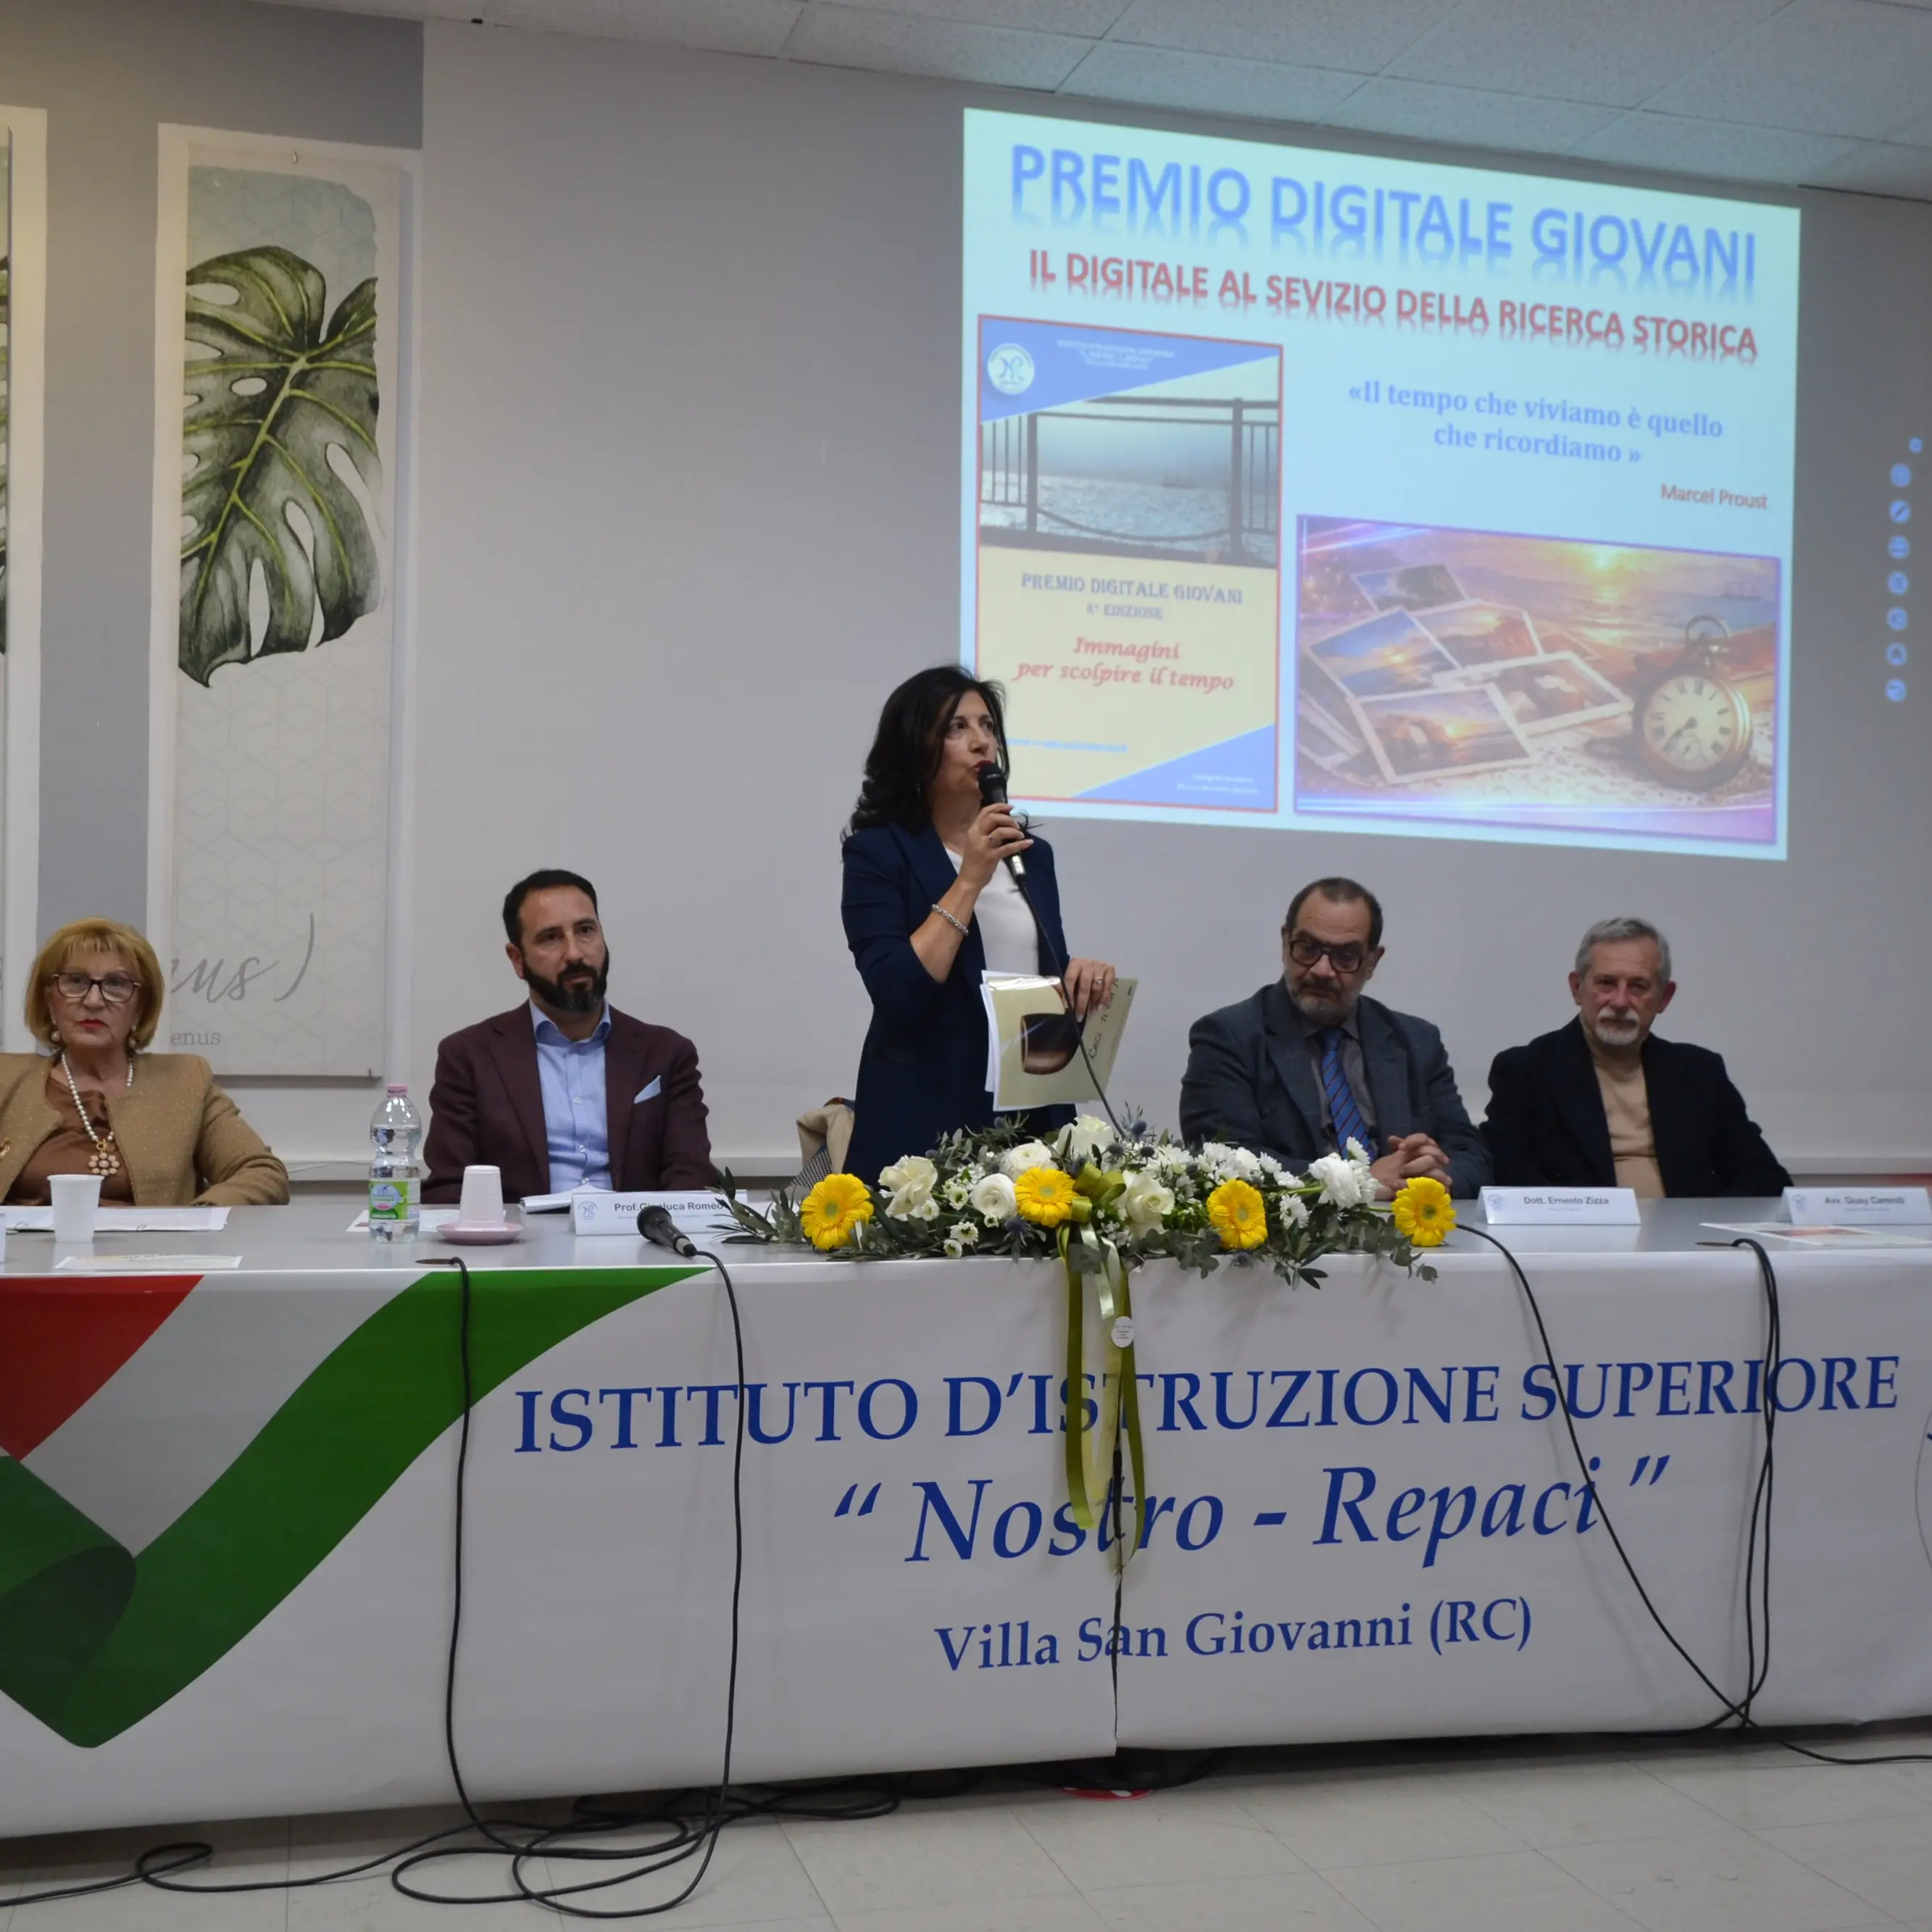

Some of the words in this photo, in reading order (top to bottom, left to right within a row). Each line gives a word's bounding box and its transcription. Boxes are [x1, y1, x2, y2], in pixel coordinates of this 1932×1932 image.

[1012, 143, 1251, 222] PREMIO
[1272, 175, 1513, 255] DIGITALE
[1531, 208, 1756, 281] GIOVANI
[1030, 249, 1056, 280] IL
[1067, 252, 1209, 296] DIGITALE
[1218, 269, 1257, 303] AL
[1266, 275, 1386, 317] SEVIZIO
[1396, 288, 1490, 326] DELLA
[1499, 299, 1625, 341] RICERCA
[1633, 315, 1757, 356] STORICA
[1388, 383, 1468, 416] tempo
[1474, 392, 1517, 417] che
[1524, 398, 1621, 428] viviamo
[1628, 407, 1641, 430] è
[1647, 412, 1723, 438] quello
[1433, 423, 1477, 448] che
[1484, 428, 1622, 462] ricordiamo
[1660, 483, 1715, 505] Marcel
[1719, 489, 1768, 510] Proust
[1022, 572, 1086, 592] PREMIO
[1091, 577, 1169, 599] DIGITALE
[1173, 585, 1243, 604] GIOVANI
[1104, 603, 1163, 620] EDIZIONE
[1073, 636, 1180, 664] Immagini
[1012, 662, 1054, 681] per
[1059, 662, 1142, 688] scolpire
[1150, 666, 1168, 685] il
[1170, 670, 1234, 694] tempo
[514, 1378, 917, 1452] ISTITUTO
[1520, 1356, 1899, 1420] SUPERIORE
[904, 1476, 1224, 1562] Nostro
[1312, 1457, 1602, 1568] Repaci
[934, 1620, 1060, 1670] Villa
[1078, 1616, 1168, 1662] San
[1186, 1602, 1412, 1656] Giovanni
[1429, 1596, 1531, 1656] (RC)
